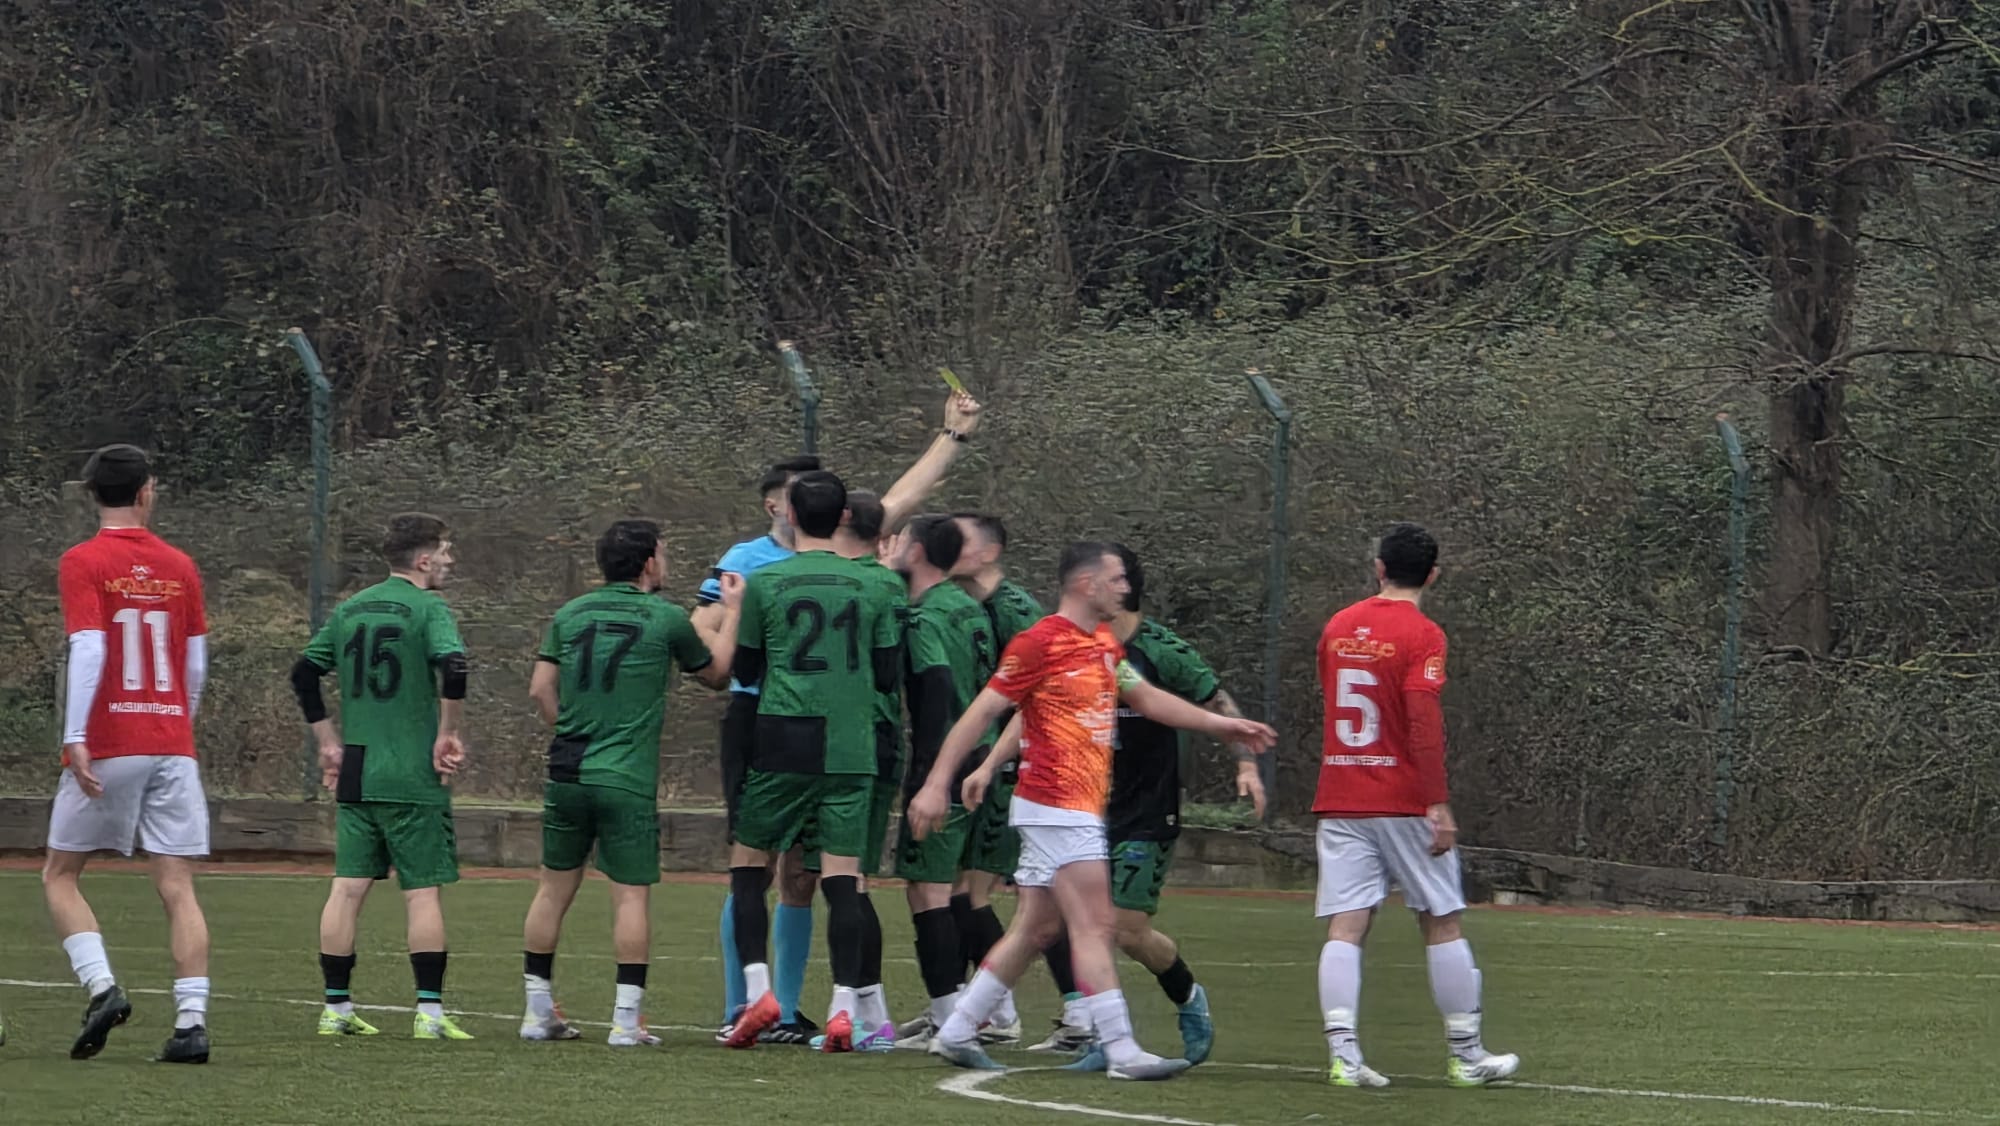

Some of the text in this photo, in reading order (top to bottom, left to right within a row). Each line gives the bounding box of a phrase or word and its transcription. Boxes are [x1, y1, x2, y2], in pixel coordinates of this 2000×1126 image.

[112, 608, 173, 692] 11
[344, 622, 403, 702] 15
[571, 620, 643, 693] 17
[786, 596, 860, 675] 21
[1335, 668, 1380, 747] 5
[1120, 864, 1141, 895] 7
